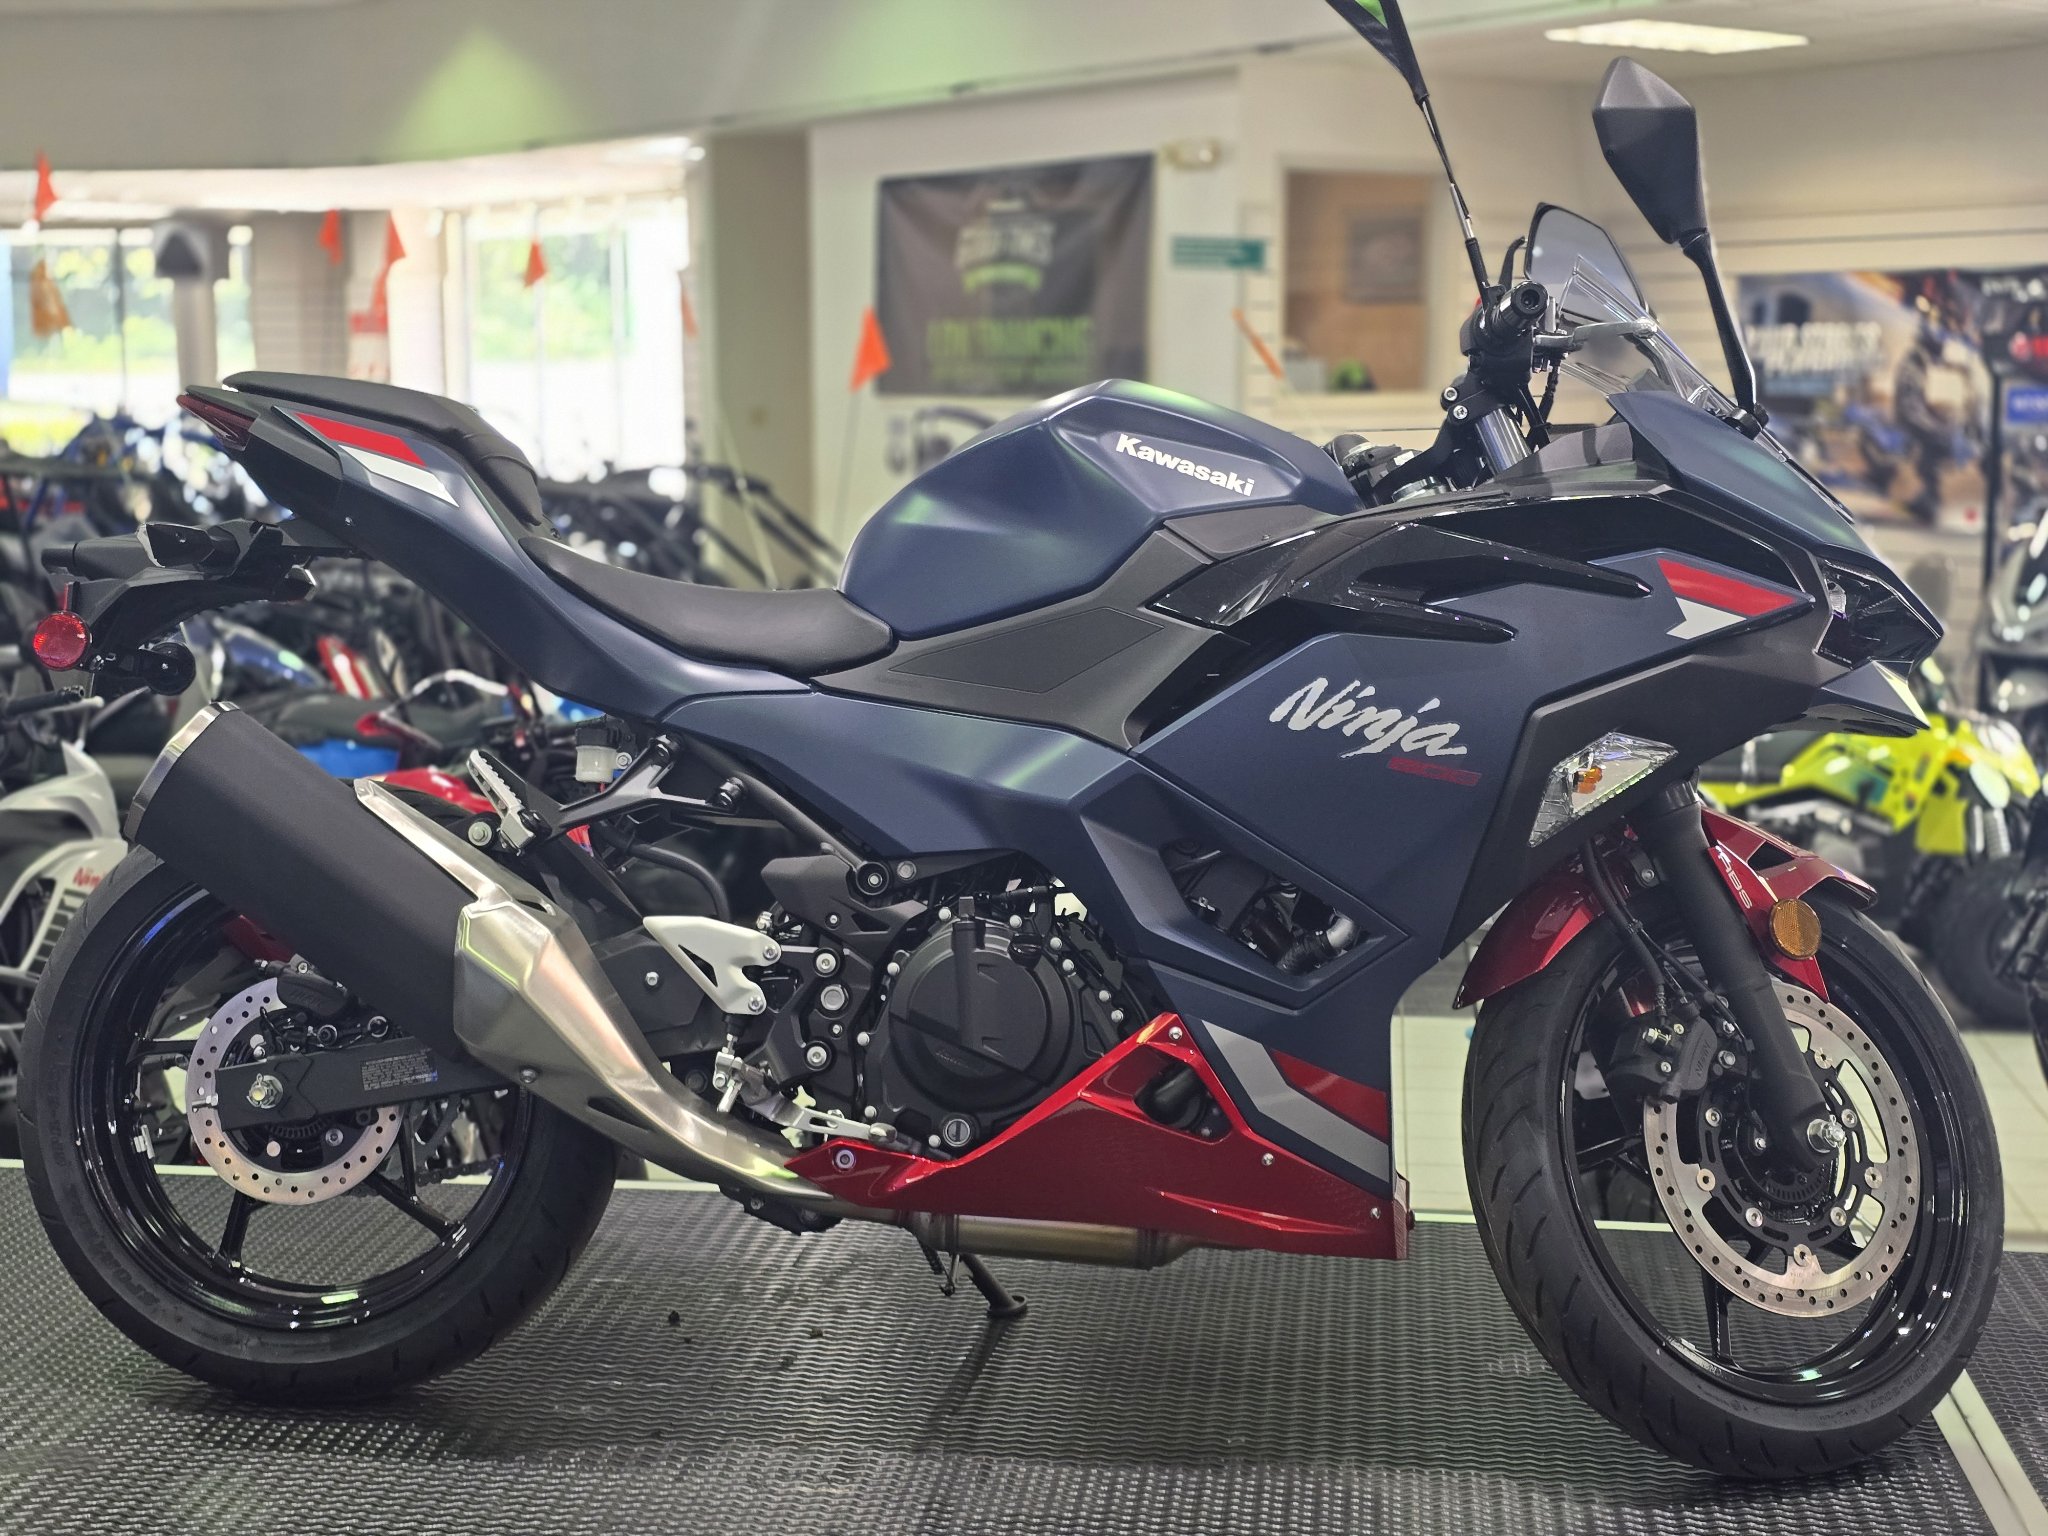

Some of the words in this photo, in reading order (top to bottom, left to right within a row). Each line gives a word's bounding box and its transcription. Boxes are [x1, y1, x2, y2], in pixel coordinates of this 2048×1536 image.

[1116, 433, 1255, 497] Kawasaki
[1269, 677, 1467, 758] Ninja
[73, 867, 104, 888] Nin
[1716, 846, 1752, 909] ABS
